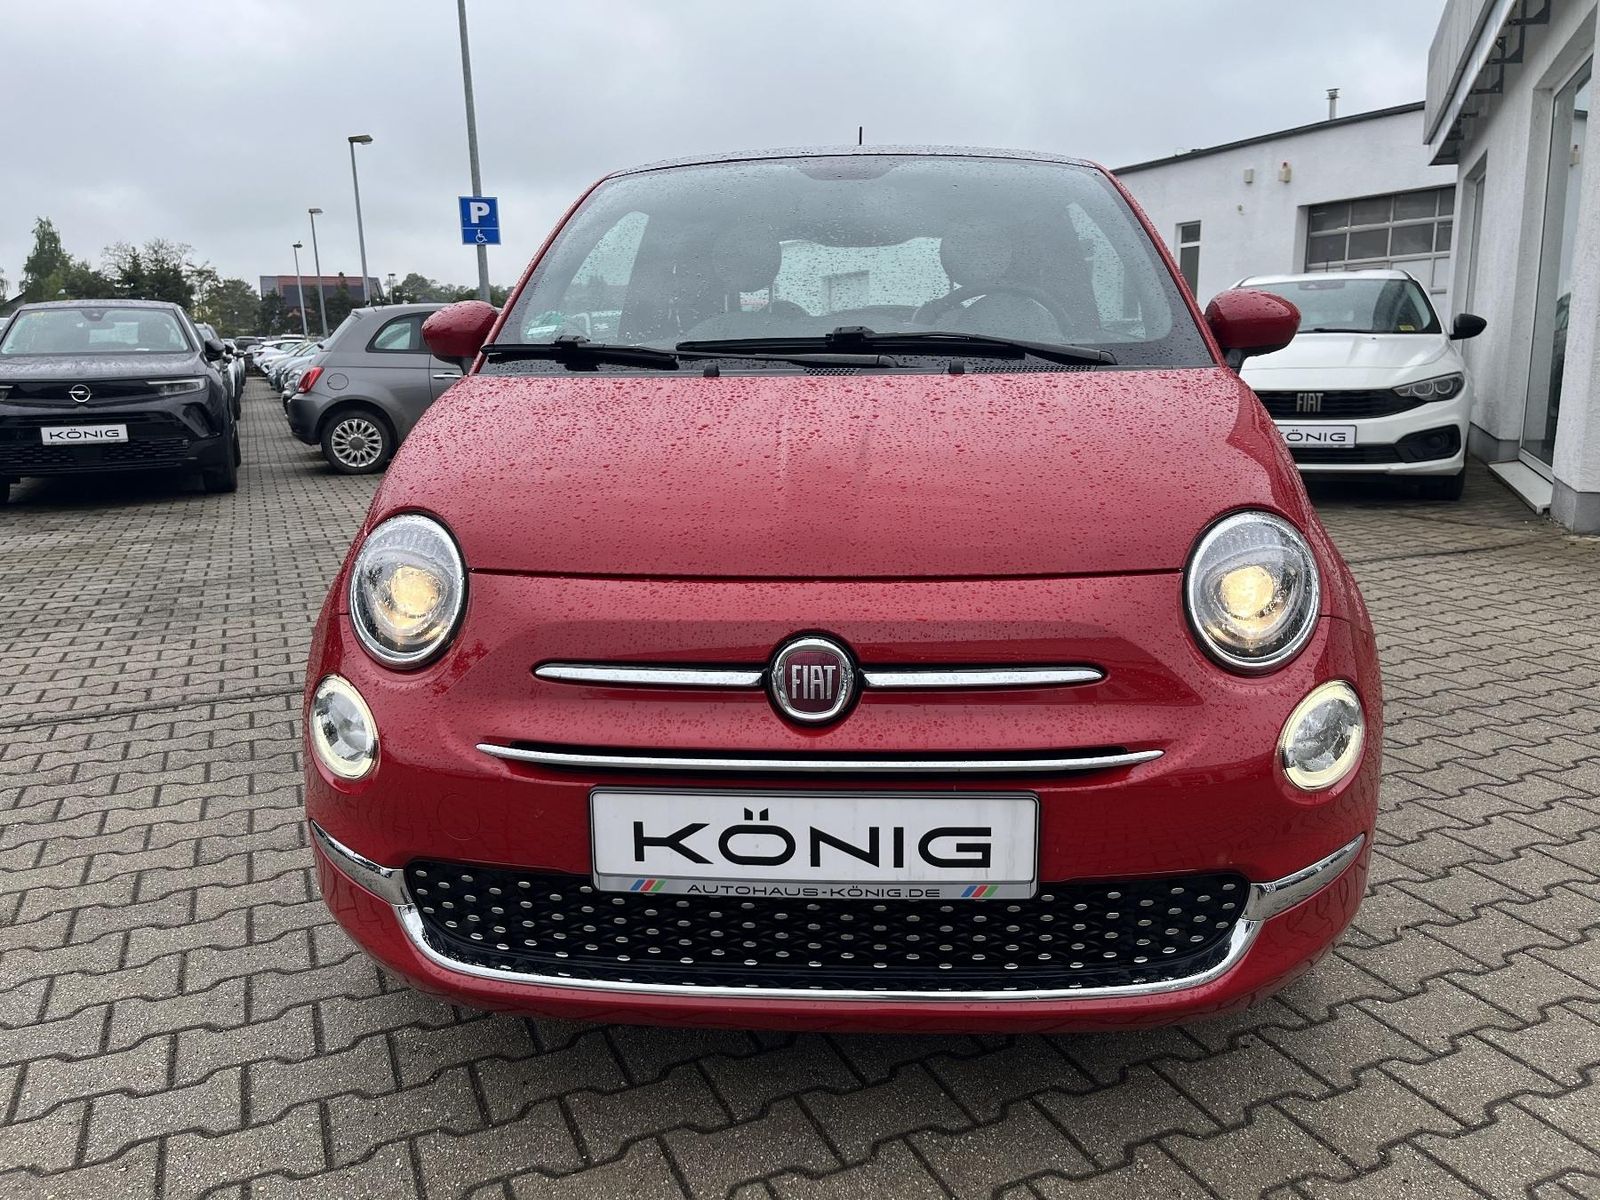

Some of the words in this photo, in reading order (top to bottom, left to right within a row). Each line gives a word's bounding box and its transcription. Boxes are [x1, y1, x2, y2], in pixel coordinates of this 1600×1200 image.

[469, 201, 490, 224] P
[1296, 392, 1324, 412] FIAT
[49, 428, 119, 440] KÖNIG
[1280, 428, 1346, 442] ÖNIG
[791, 664, 837, 700] FIAT
[633, 807, 992, 869] KÖNIG
[686, 883, 941, 899] AUTOHAUS-KÖNIG.DE
